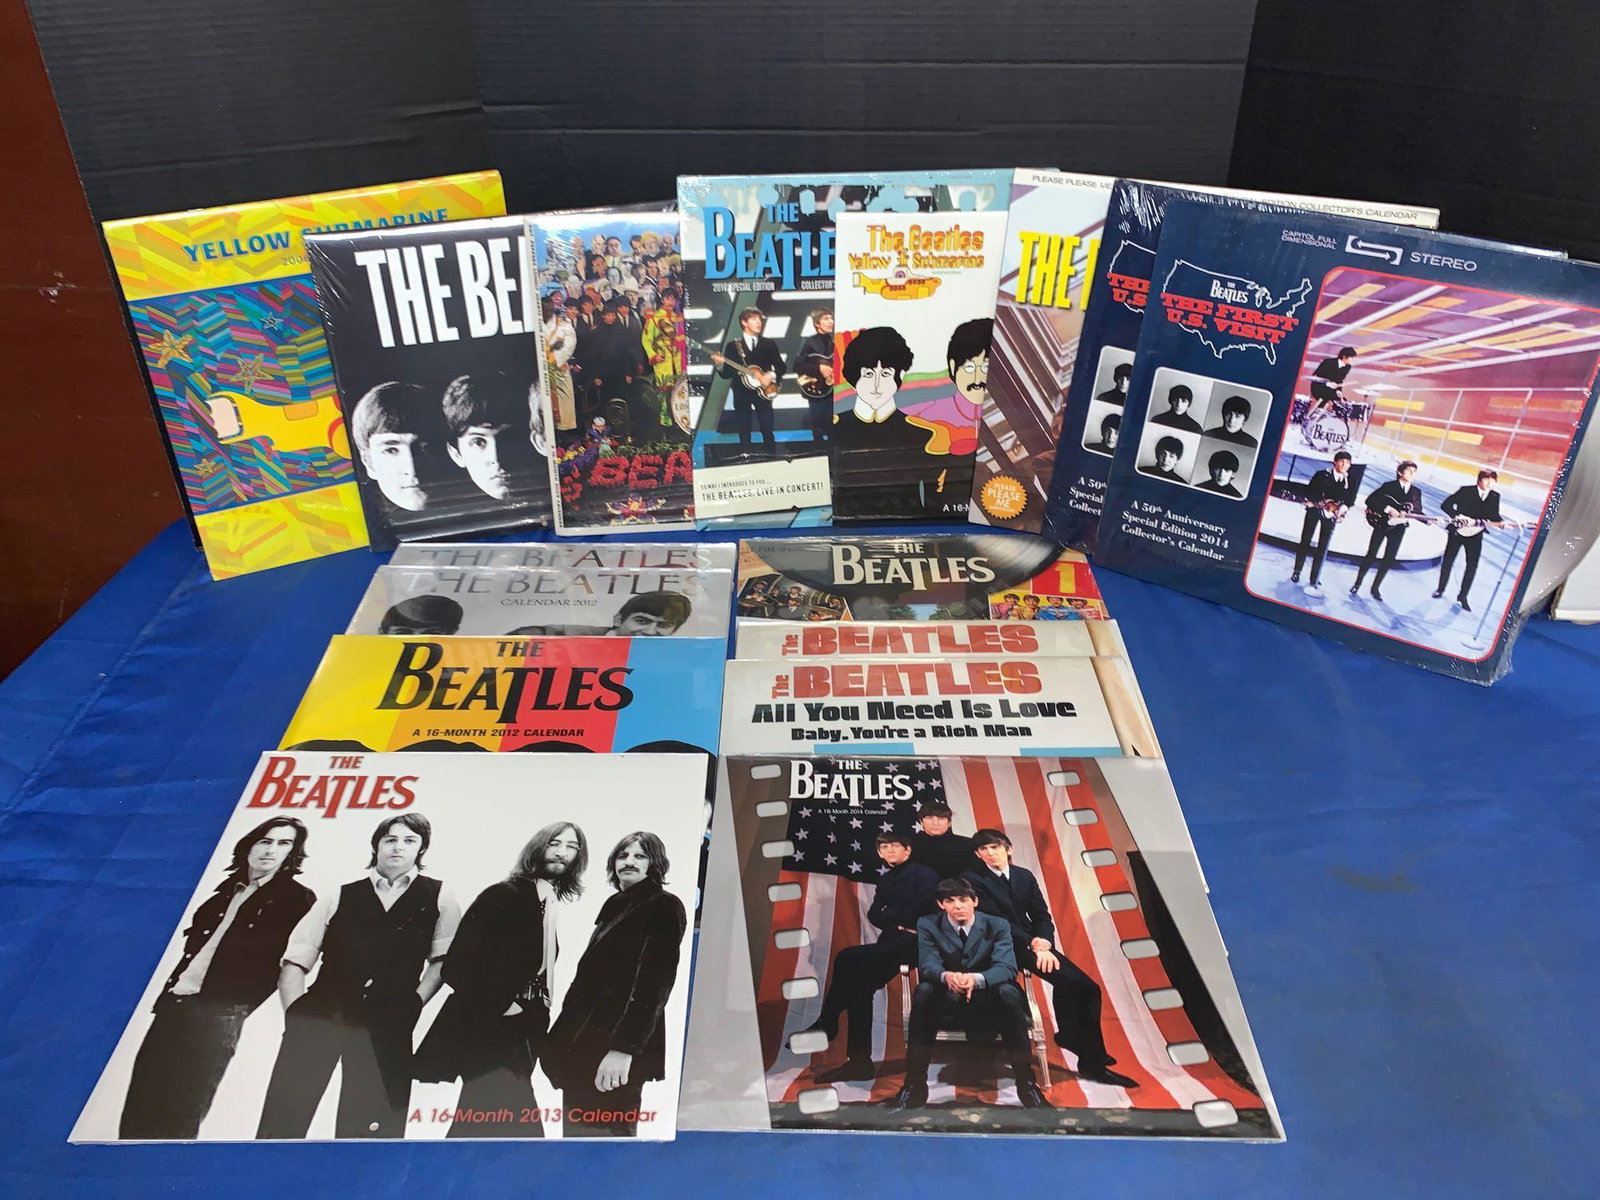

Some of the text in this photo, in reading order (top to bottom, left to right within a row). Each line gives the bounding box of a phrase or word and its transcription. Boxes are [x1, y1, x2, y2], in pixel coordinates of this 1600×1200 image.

[1032, 175, 1064, 184] PLEASE
[1065, 177, 1098, 188] PLEASE
[766, 202, 800, 223] THE
[1299, 200, 1363, 215] COLLECTOR'S
[1365, 205, 1418, 220] CALENDAR
[182, 230, 290, 262] YELLOW
[866, 223, 985, 252] The Beatles
[1281, 235, 1336, 250] DIMENSIONAL
[1282, 229, 1338, 245] CAPITOL FULL
[703, 206, 836, 290] BEATLE
[848, 251, 985, 270] Yellow Submarine
[1016, 230, 1081, 310] THE
[1410, 251, 1478, 272] STEREO
[753, 281, 775, 292] EDITION
[1210, 279, 1249, 304] BEATLES
[1226, 281, 1236, 289] THE
[354, 243, 460, 348] THE
[1160, 291, 1299, 332] THE FIRST
[1166, 307, 1286, 344] U.S. VISIT
[1313, 424, 1346, 445] BEATLES
[702, 492, 716, 501] THE
[757, 487, 773, 497] LIVE
[776, 486, 784, 494] IN
[786, 481, 824, 493] CONCERT!
[721, 480, 748, 488] INTRODUCE
[994, 483, 1016, 492] PLEASE
[1077, 476, 1085, 486] A
[987, 488, 1021, 502] PLEASE
[995, 498, 1011, 508] ME
[1069, 486, 1104, 504] Special
[942, 504, 950, 512] A
[1068, 499, 1102, 517] Collect
[1130, 500, 1227, 536] A 50th Anniversary
[1121, 510, 1230, 550] Special Edition 2014
[894, 543, 924, 554] THE
[1121, 523, 1225, 562] Collector's Calendar
[831, 544, 996, 591] BEATLES
[401, 571, 709, 596] THE BEATLES
[1054, 563, 1076, 594] 1
[500, 598, 598, 607] CALENDAR 2012
[495, 640, 546, 658] THE
[781, 624, 1040, 656] The BEATLES
[374, 641, 635, 724] BEATLES
[771, 661, 1042, 700] The BEATLES
[751, 698, 1077, 723] All You Need Is Love
[412, 728, 585, 738] A 16-MONTH 2012 CALENDAR
[791, 724, 1032, 742] Baby, You're a Rich Man
[329, 755, 364, 769] THE
[836, 759, 863, 770] THE
[246, 756, 420, 819] BEATLES
[789, 759, 914, 807] BEATLES
[408, 1107, 657, 1123] A 16-Month 2013 Calendar
